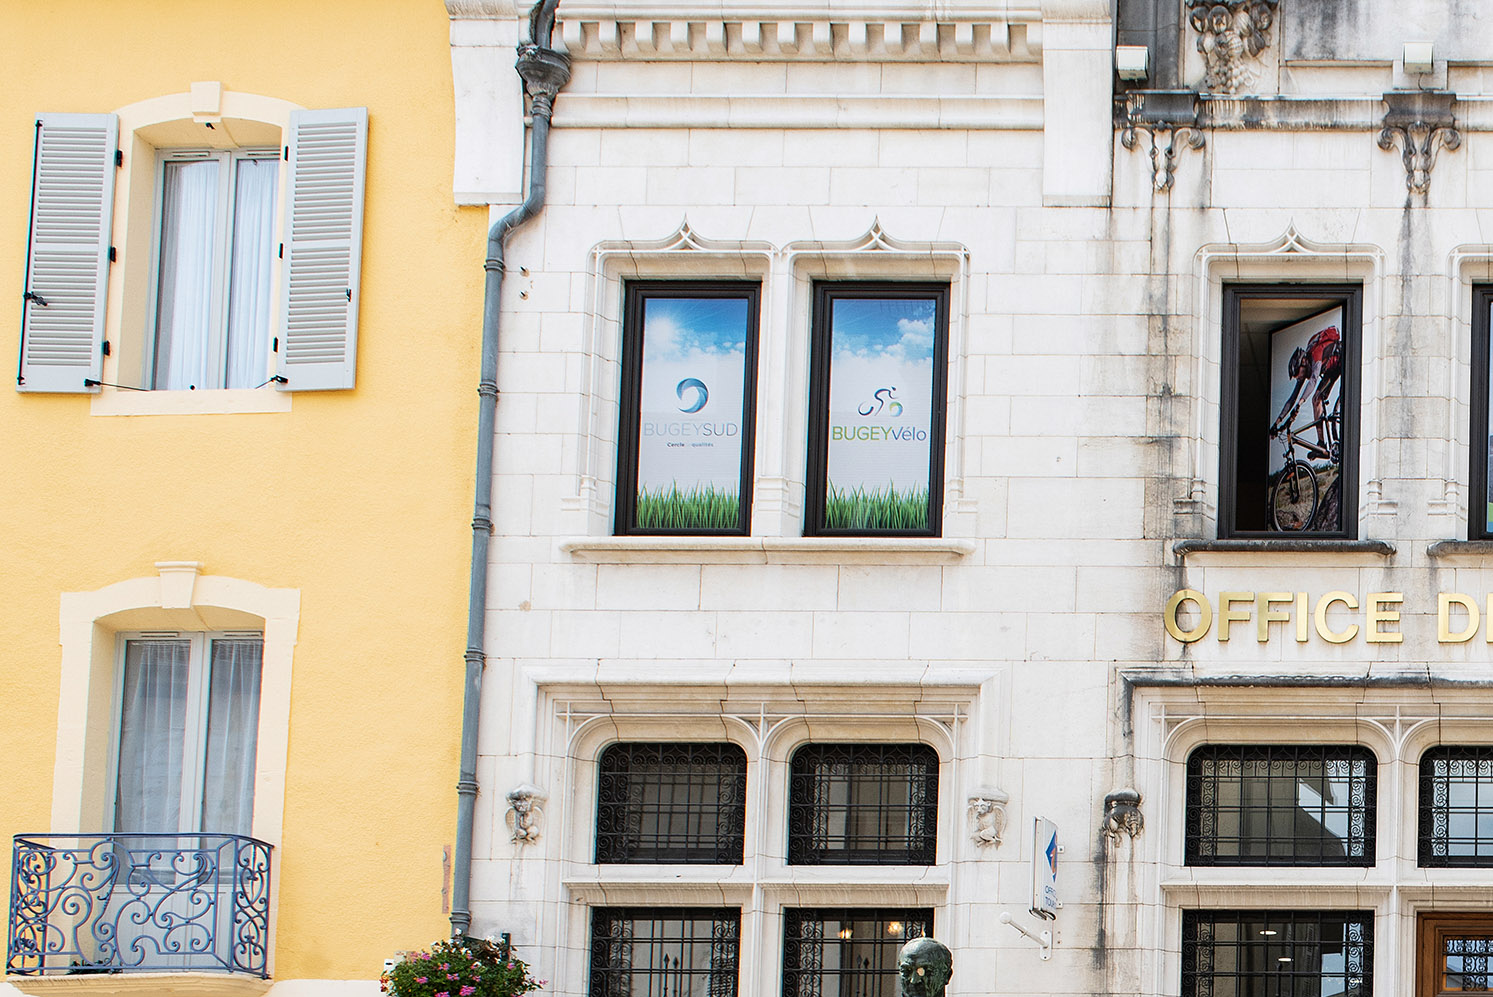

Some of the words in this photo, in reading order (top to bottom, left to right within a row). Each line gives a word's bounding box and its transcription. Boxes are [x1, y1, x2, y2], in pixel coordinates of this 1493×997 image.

[643, 422, 739, 437] BUGEYSUD
[831, 424, 928, 441] BUGEYVélo
[1162, 590, 1405, 645] OFFICE
